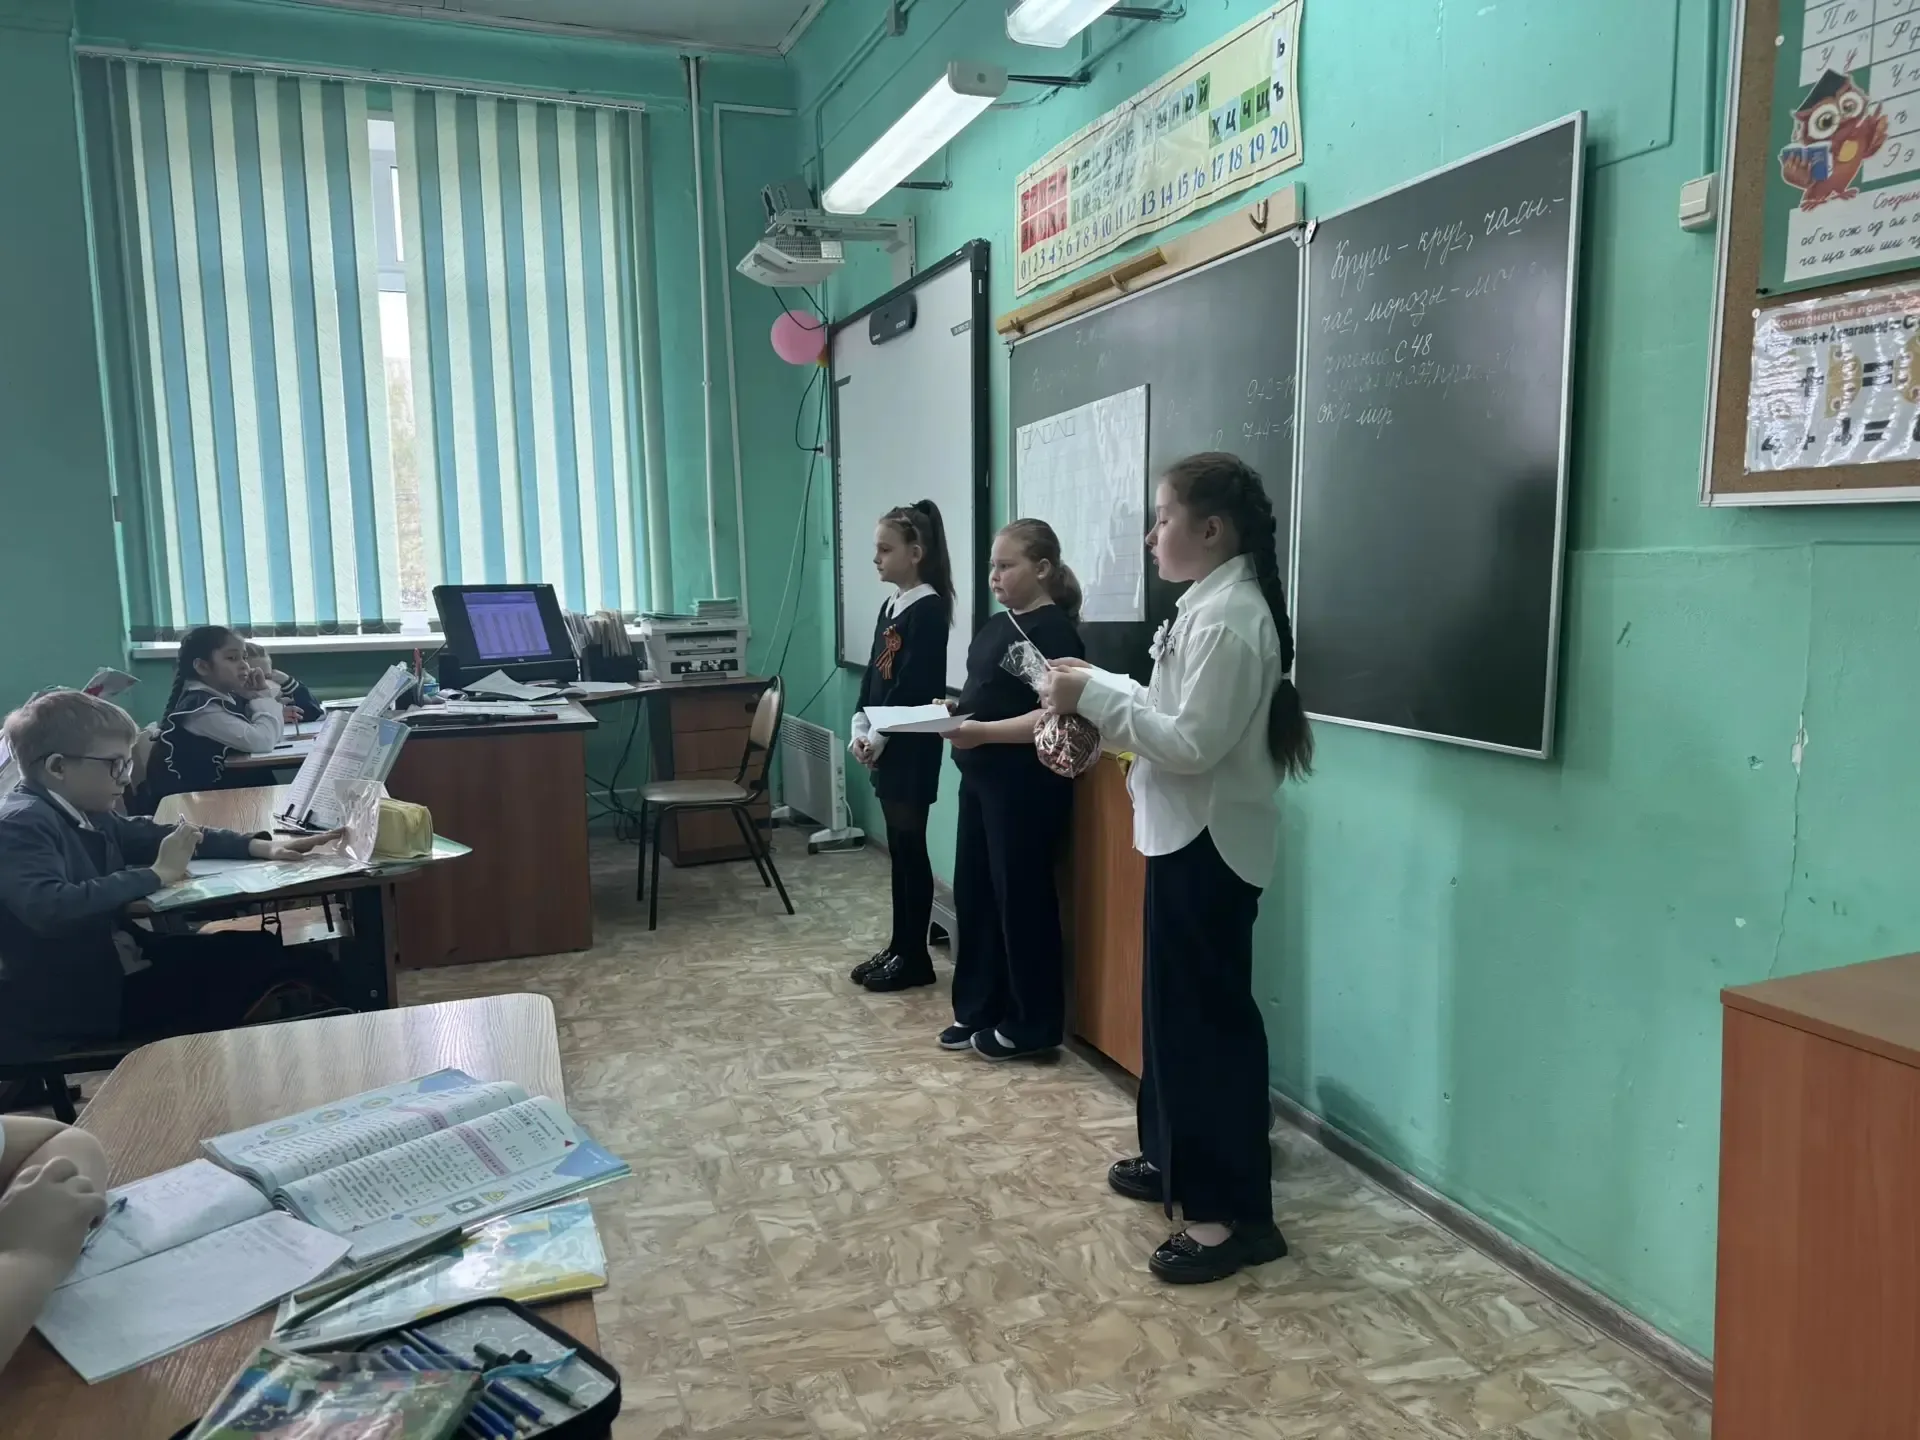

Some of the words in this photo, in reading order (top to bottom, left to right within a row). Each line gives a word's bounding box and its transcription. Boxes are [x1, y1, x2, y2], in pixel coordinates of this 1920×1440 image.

[1199, 78, 1208, 105] й
[1225, 108, 1237, 131] ц
[1243, 99, 1251, 119] ч
[1102, 213, 1112, 238] 10
[1141, 190, 1156, 216] 13
[1161, 181, 1173, 209] 14
[1178, 172, 1189, 200] 15
[1193, 164, 1206, 192] 16
[1211, 153, 1224, 183] 17
[1229, 144, 1243, 173] 18
[1249, 133, 1265, 164] 19
[1271, 121, 1289, 154] 20
[1331, 240, 1391, 298] Круги
[1365, 286, 1447, 334] морозы
[1411, 333, 1432, 358] 48
